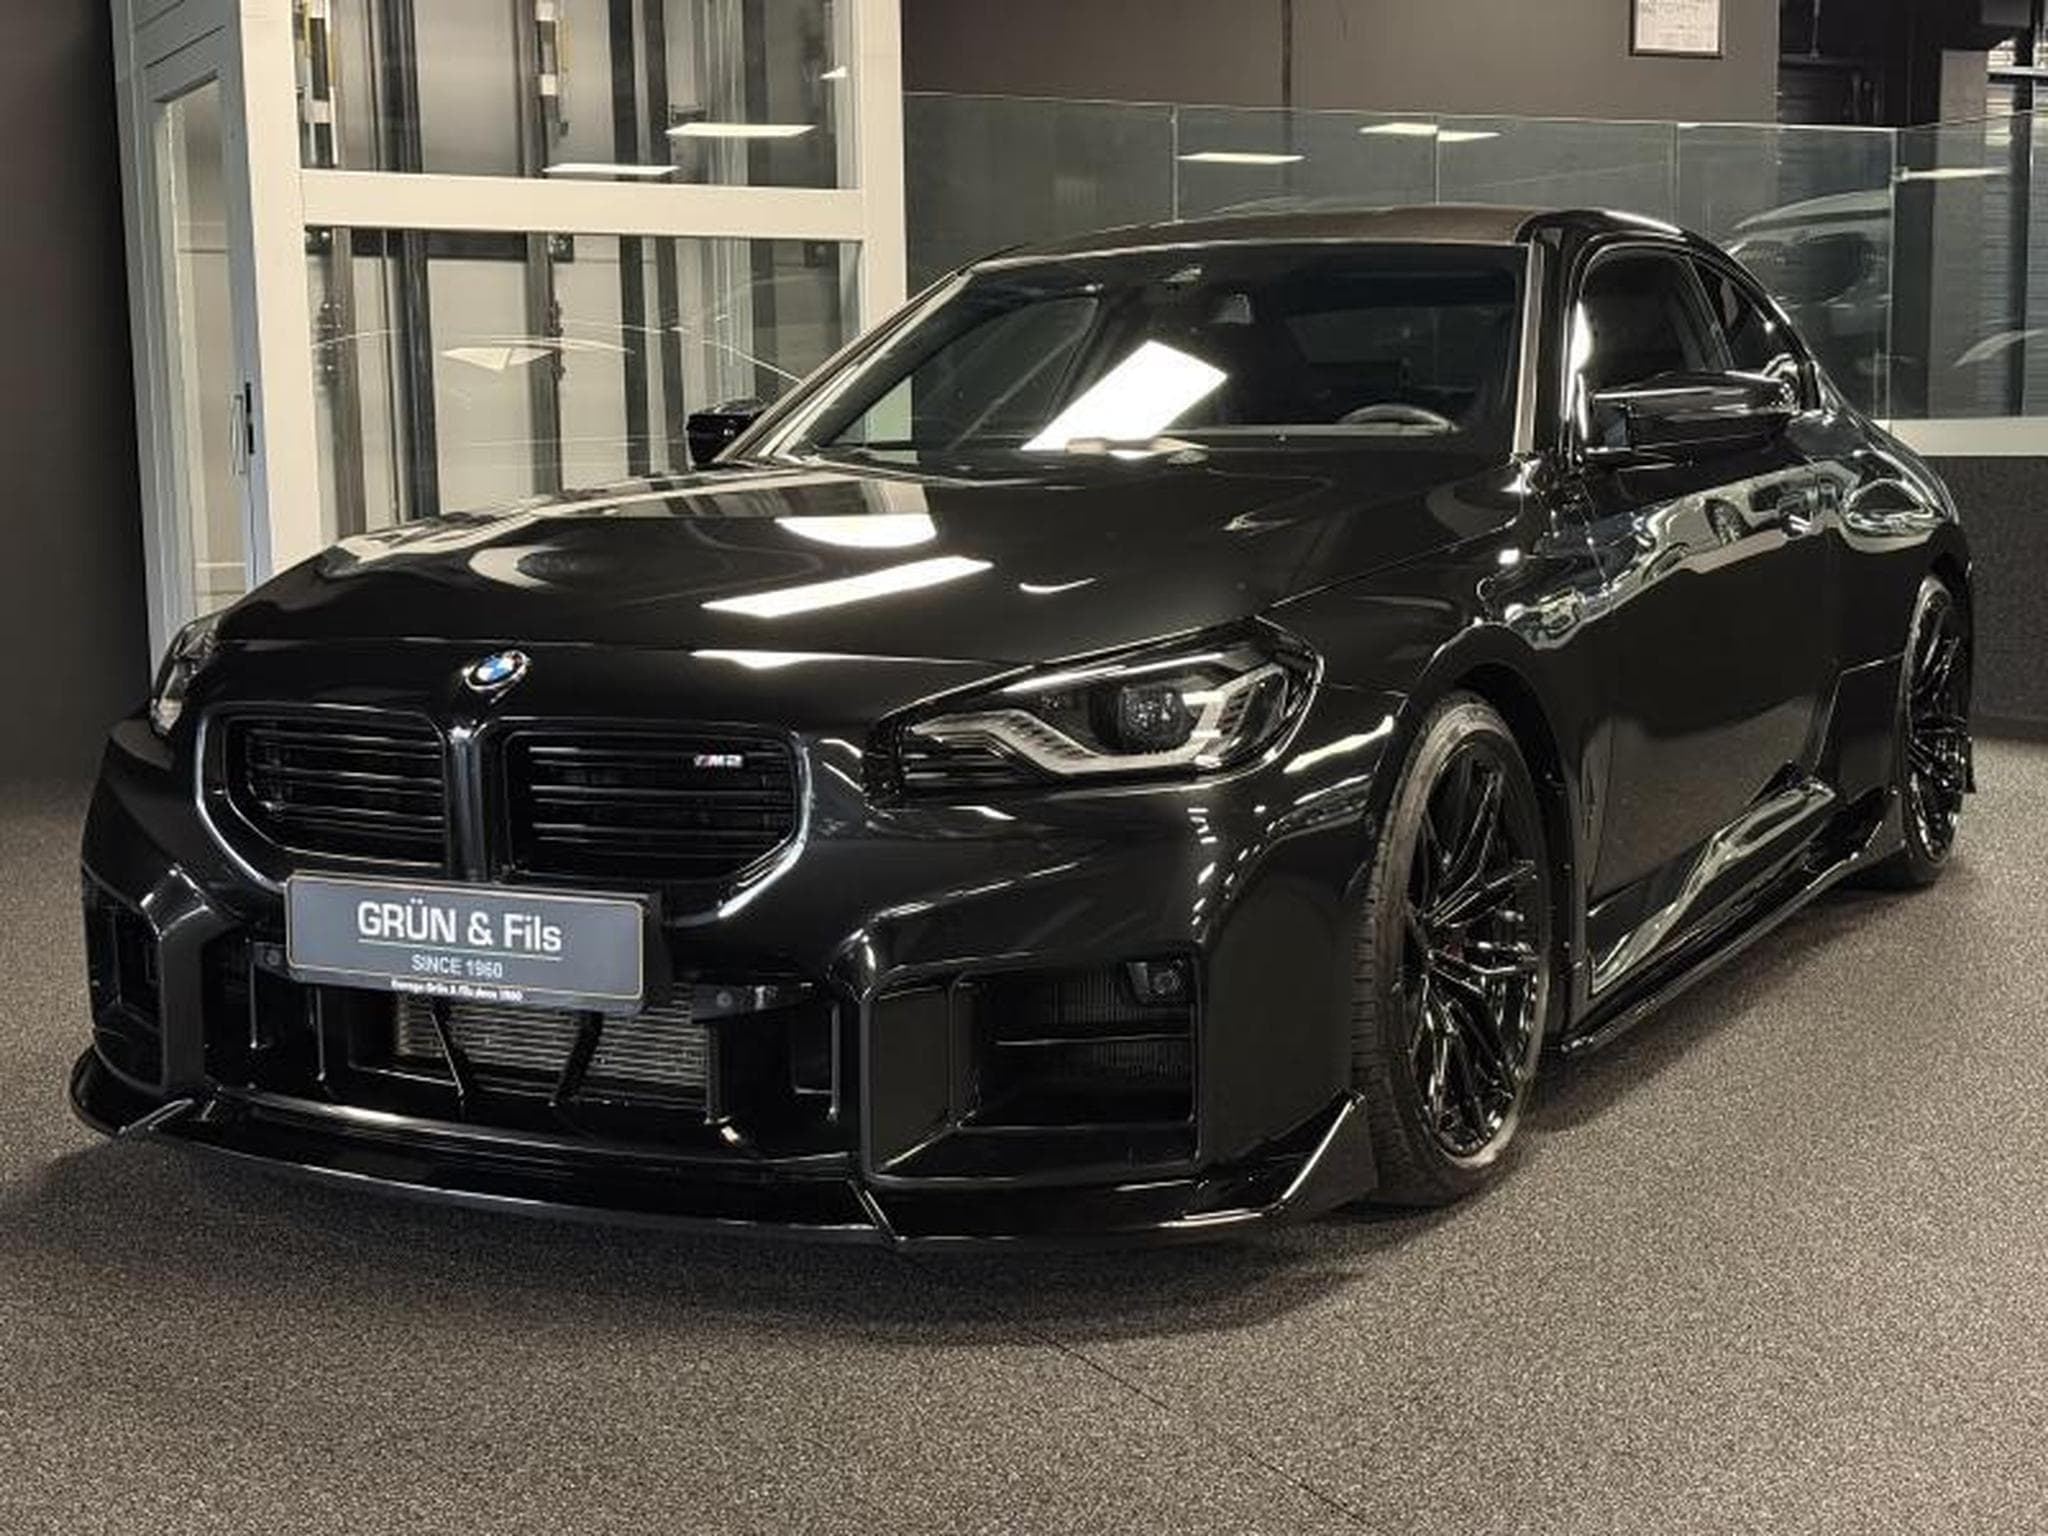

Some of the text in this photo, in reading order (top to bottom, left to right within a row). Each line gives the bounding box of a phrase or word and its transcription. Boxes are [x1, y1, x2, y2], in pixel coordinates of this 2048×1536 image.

[358, 898, 562, 951] GRÜN & Fils
[411, 954, 503, 978] SINCE 1960
